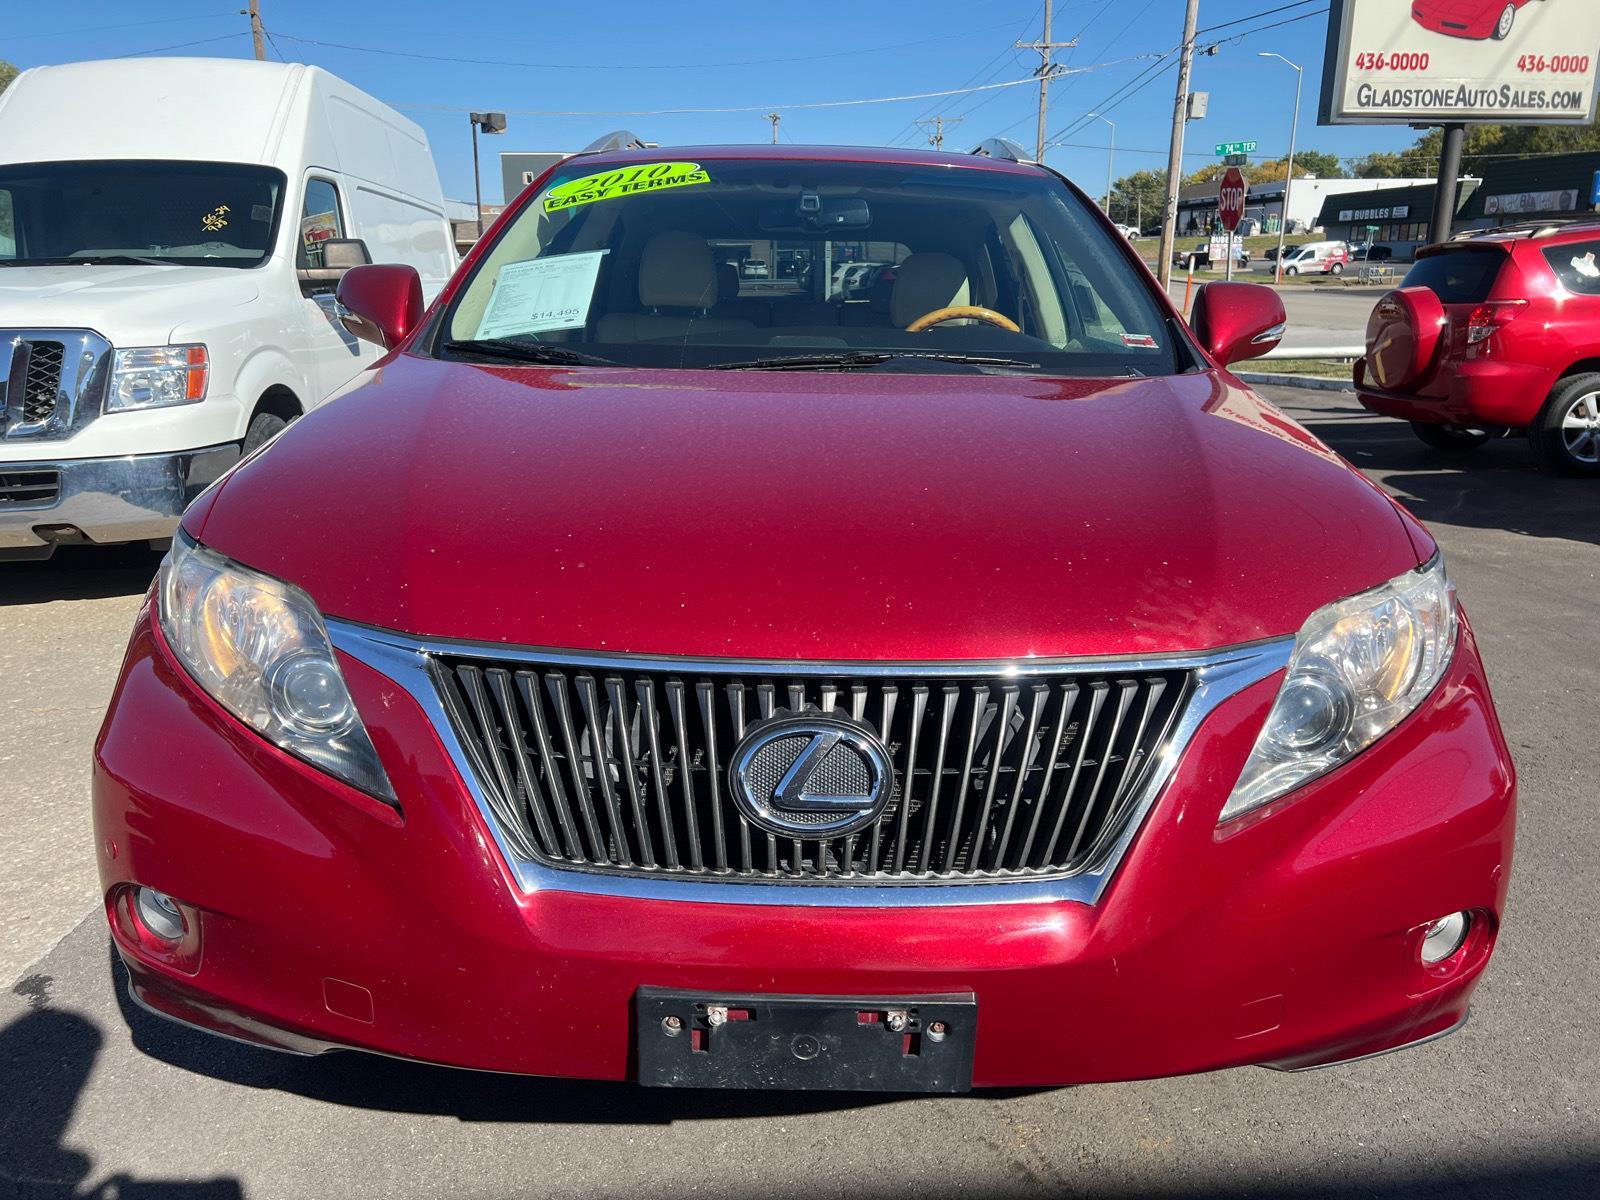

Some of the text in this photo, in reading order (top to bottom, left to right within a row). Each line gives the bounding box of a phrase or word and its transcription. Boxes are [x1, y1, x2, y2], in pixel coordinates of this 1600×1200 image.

[1356, 53, 1429, 70] 436-0000
[1517, 55, 1589, 73] 436-0000
[1243, 142, 1256, 152] TER
[574, 165, 672, 193] 2010
[549, 173, 703, 208] EASY TERMS
[1221, 187, 1243, 211] STOP
[1355, 208, 1389, 219] BUBBLES
